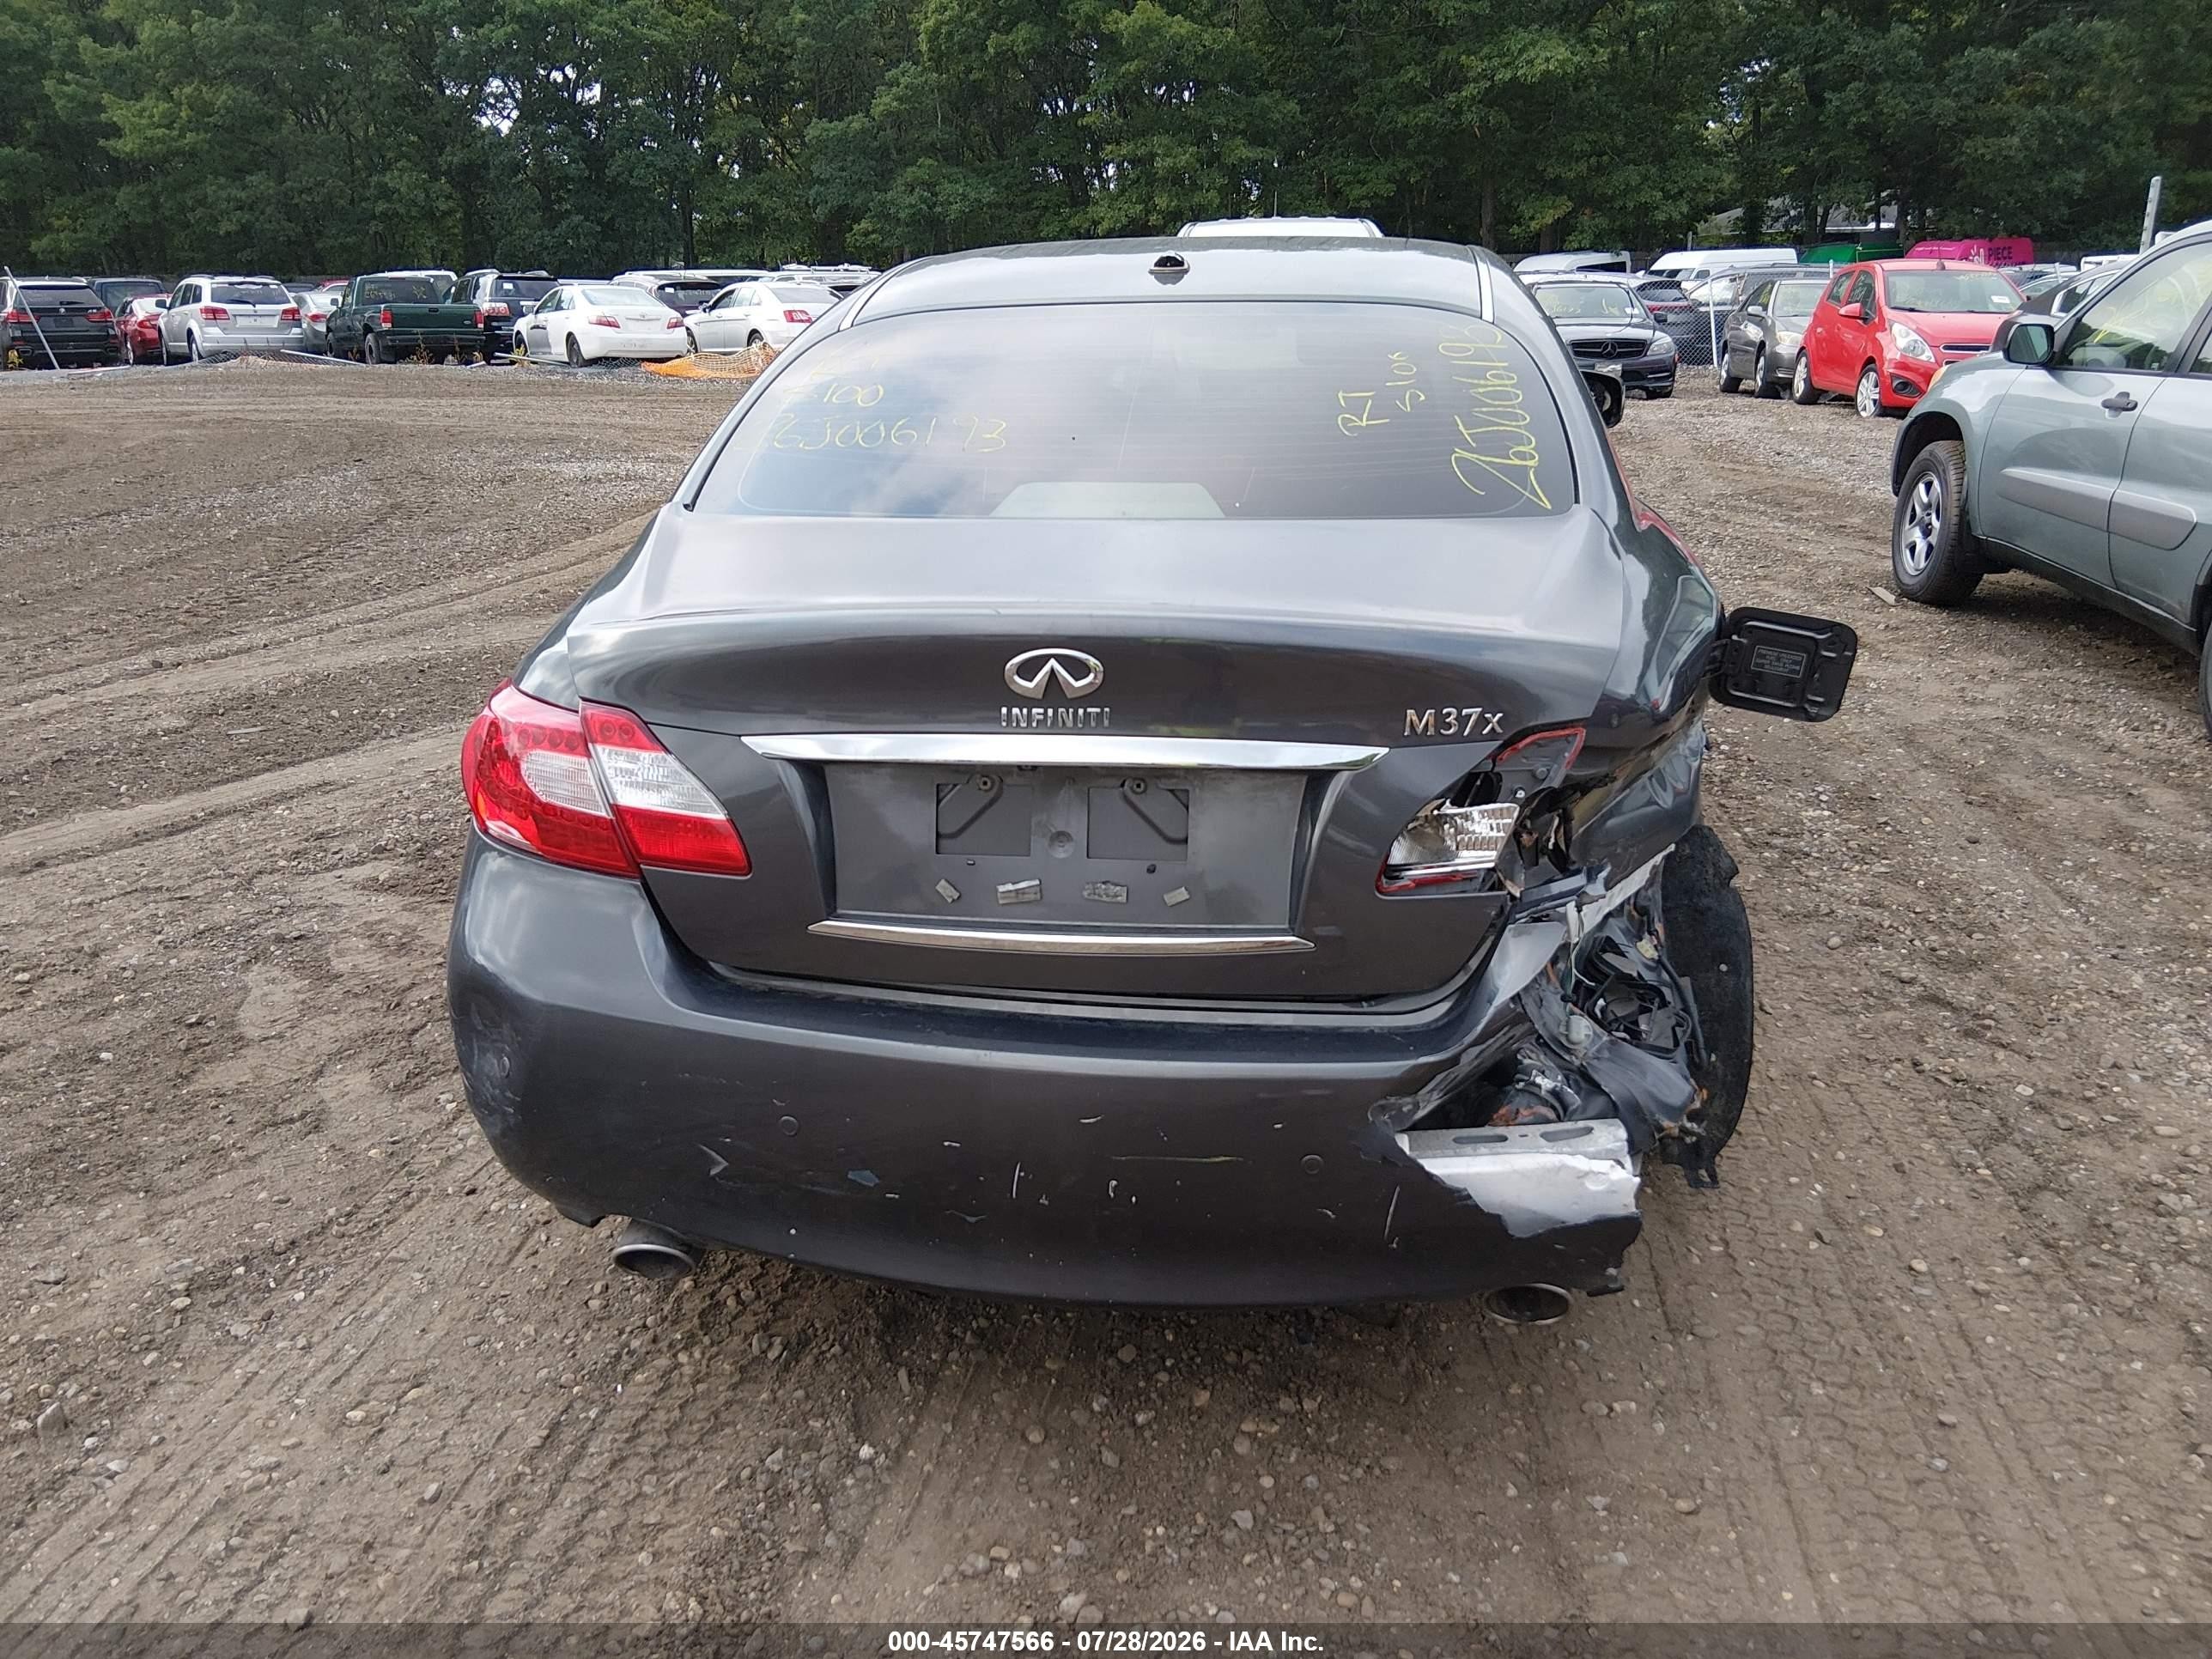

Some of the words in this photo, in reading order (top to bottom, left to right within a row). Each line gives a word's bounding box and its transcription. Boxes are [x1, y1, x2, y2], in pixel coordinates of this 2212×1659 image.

[1987, 246, 2013, 261] PIECE
[1000, 706, 1110, 728] INFINITI
[1404, 708, 1504, 736] M37x
